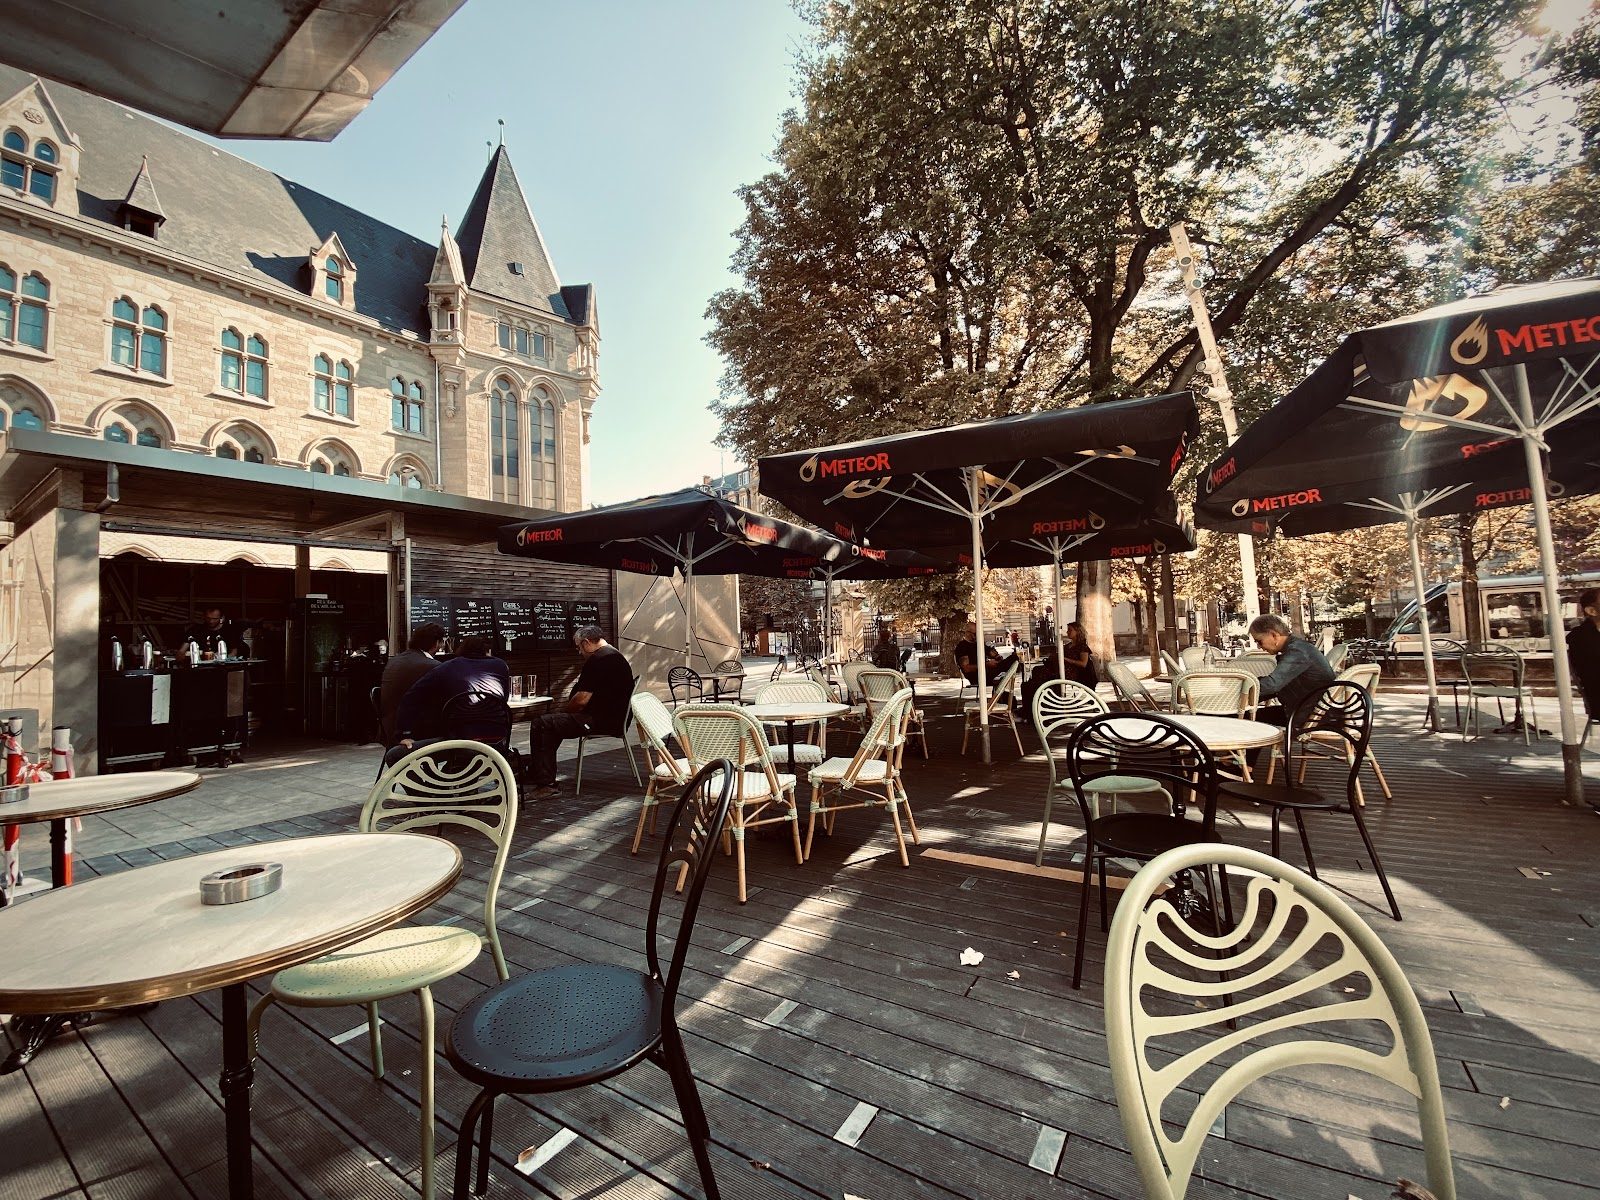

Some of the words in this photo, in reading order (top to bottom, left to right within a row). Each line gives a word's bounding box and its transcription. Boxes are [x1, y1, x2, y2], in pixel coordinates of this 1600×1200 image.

[819, 452, 892, 479] METEOR
[1211, 456, 1237, 488] METEOR
[1252, 488, 1323, 513] METEOR
[526, 528, 564, 544] METEOR
[744, 521, 779, 543] METEOR
[859, 546, 887, 561] METEOR
